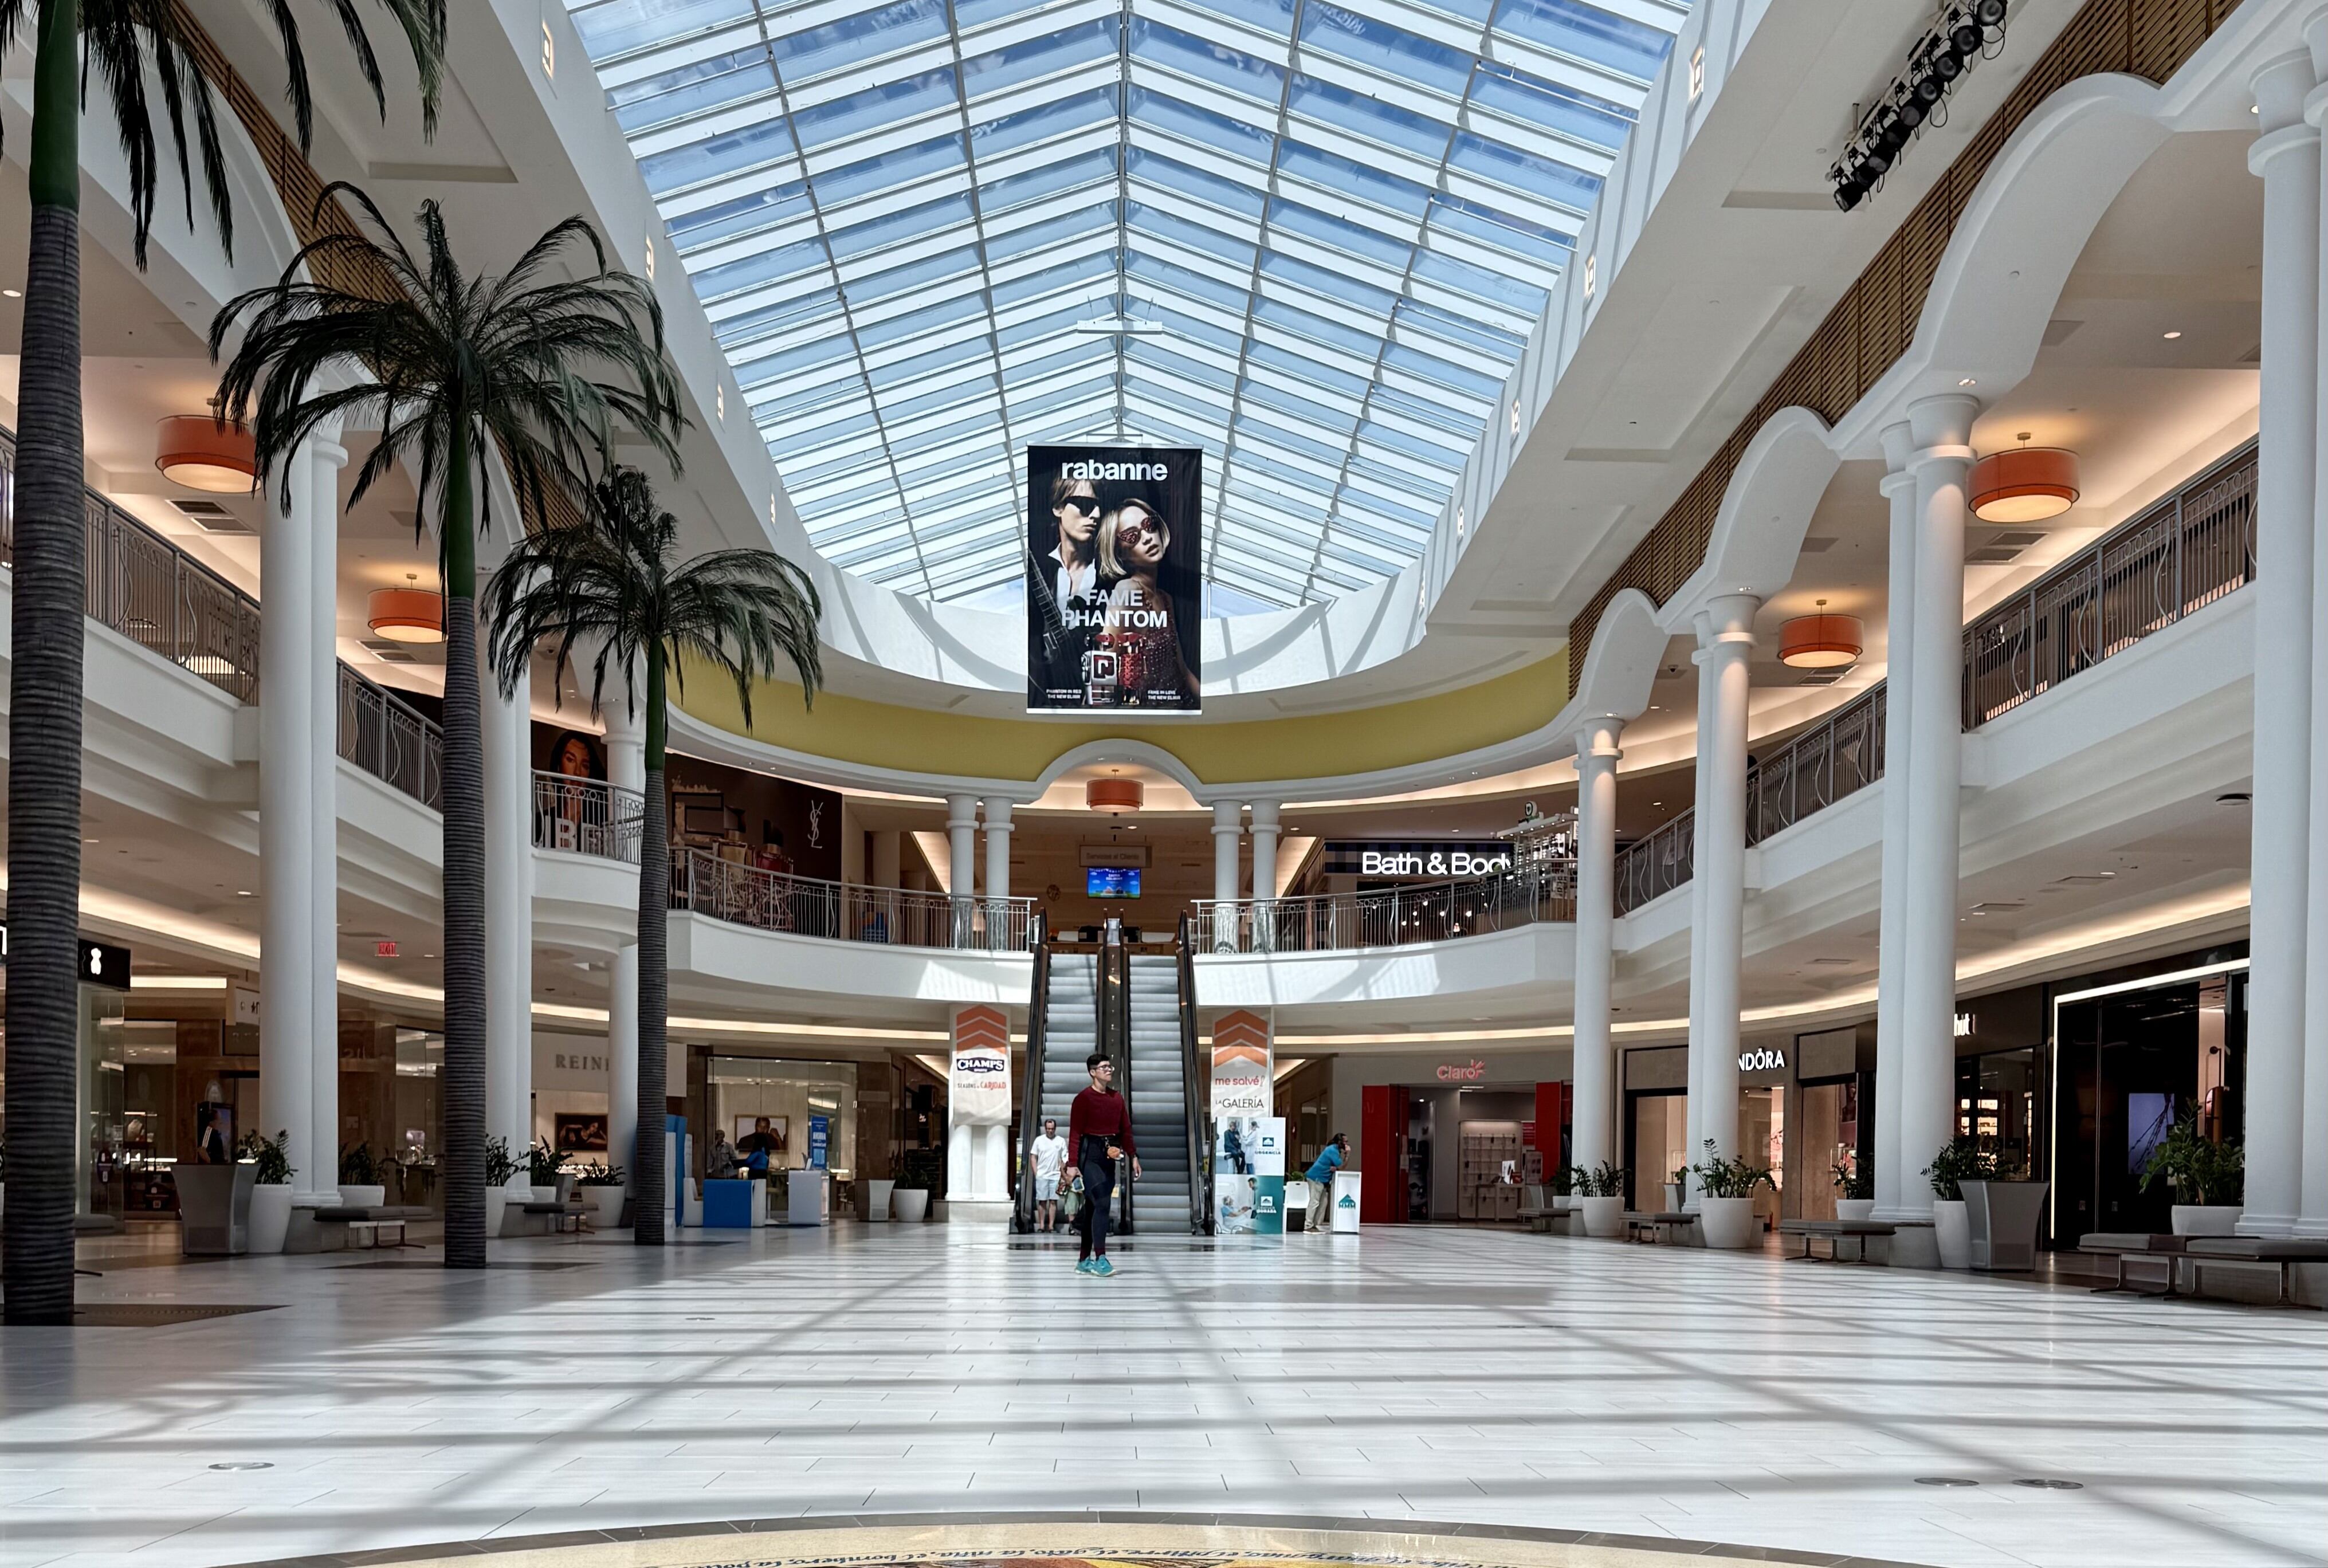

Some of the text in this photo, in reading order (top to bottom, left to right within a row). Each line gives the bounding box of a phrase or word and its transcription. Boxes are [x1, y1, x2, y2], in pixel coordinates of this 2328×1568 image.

[1062, 459, 1168, 481] rabanne
[1086, 590, 1143, 607] FAME
[1061, 610, 1167, 627] PHANTOM
[1362, 851, 1423, 875] Bath
[1427, 852, 1448, 875] &
[957, 1059, 1004, 1070] CHAMPS
[1436, 1065, 1476, 1080] Claro
[1215, 1078, 1231, 1086] me
[1222, 1095, 1264, 1109] GALERÍA
[902, 1553, 927, 1561] el
